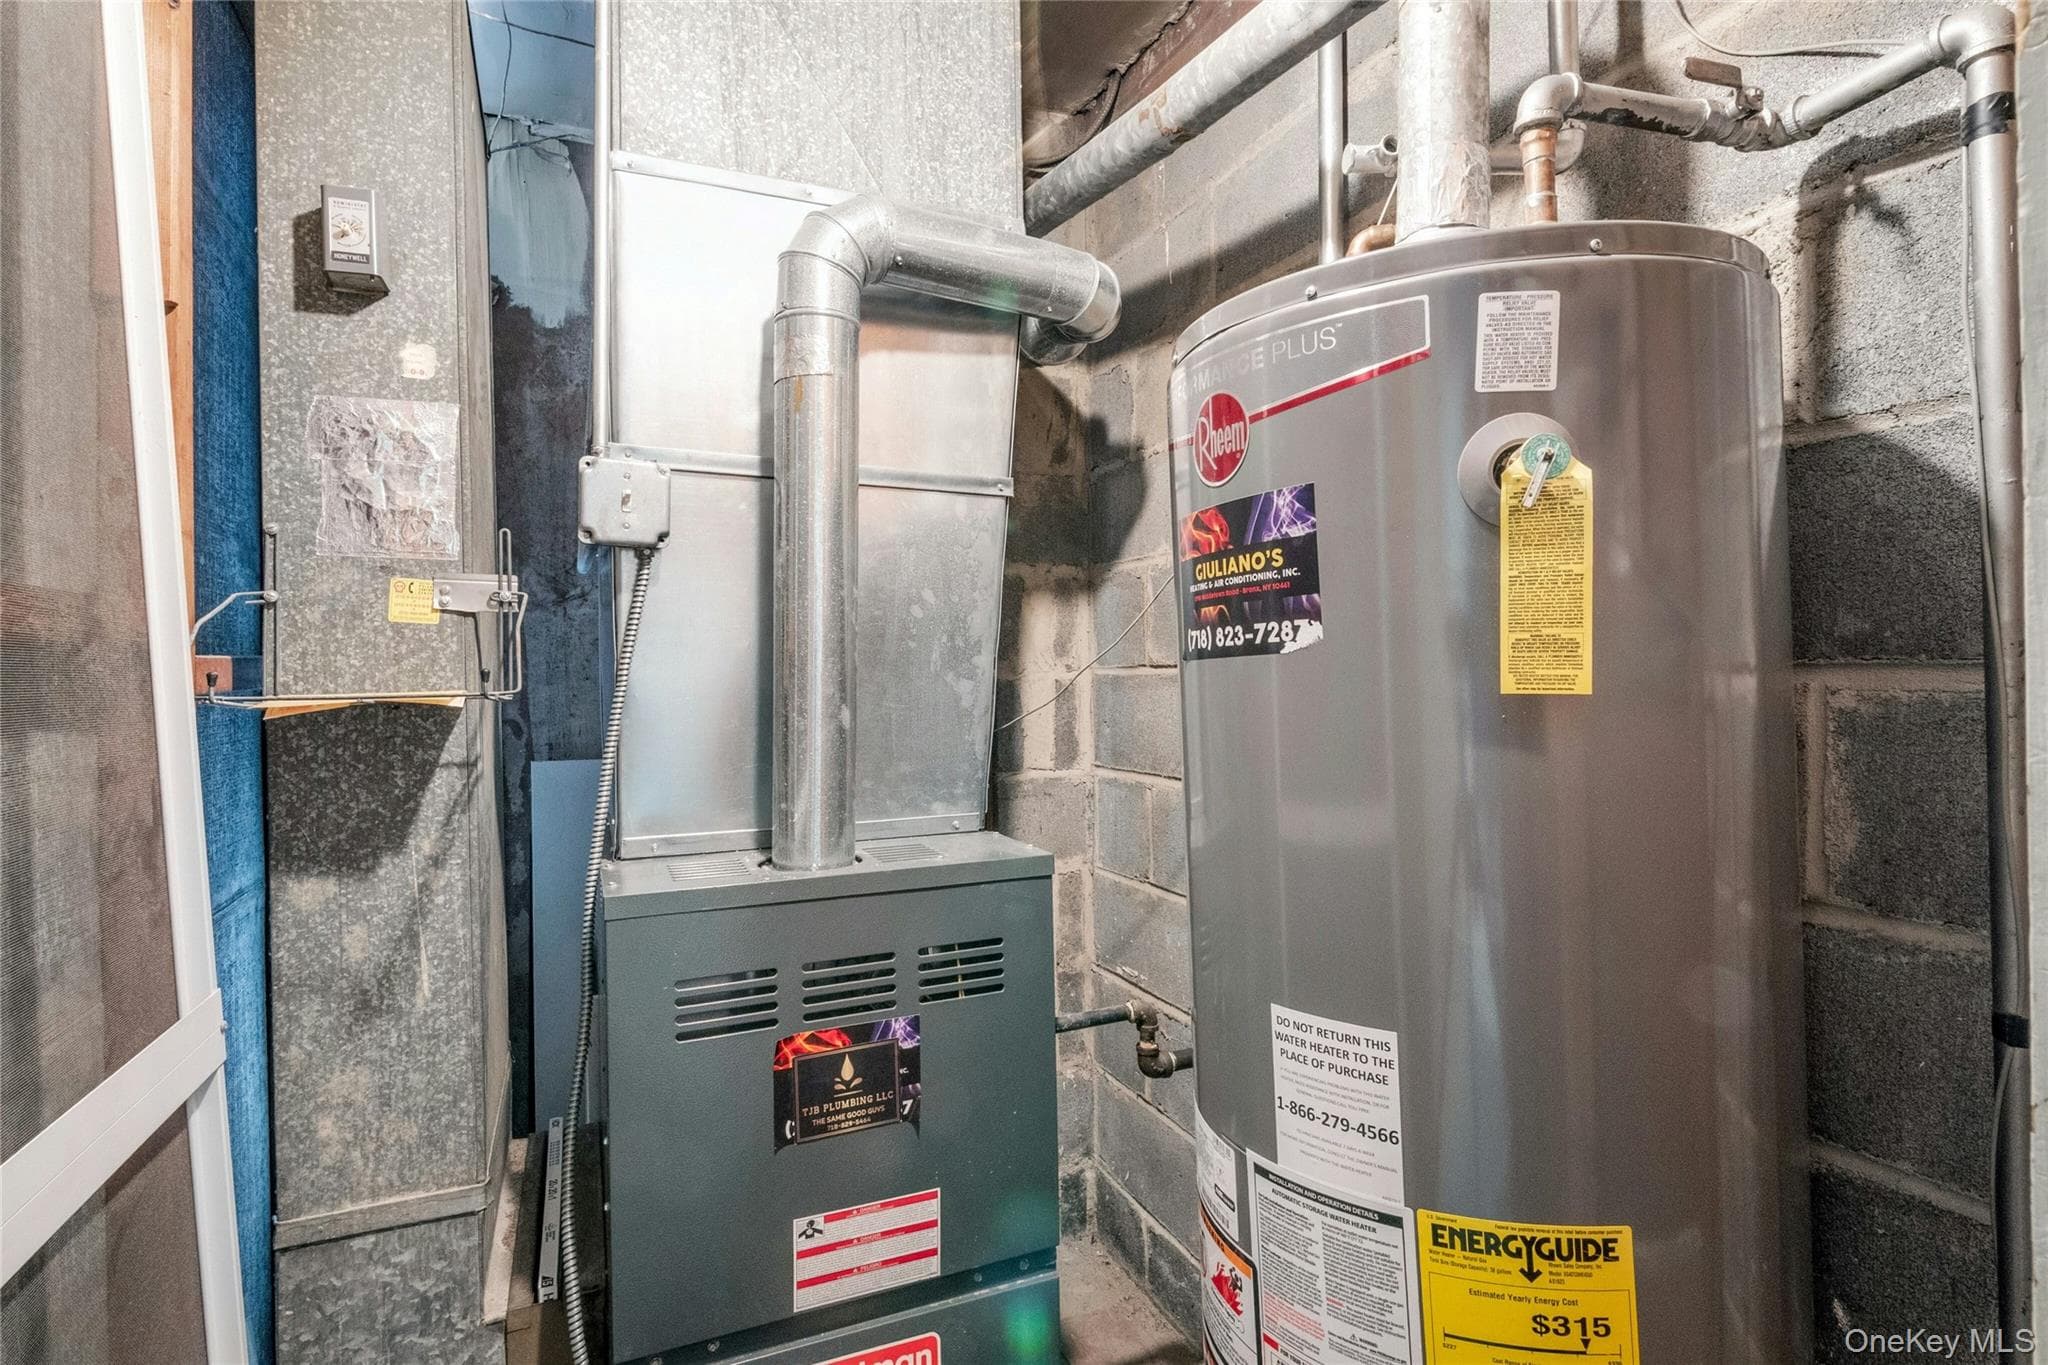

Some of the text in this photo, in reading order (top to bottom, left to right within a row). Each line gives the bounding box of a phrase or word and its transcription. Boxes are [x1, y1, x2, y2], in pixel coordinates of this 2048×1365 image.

[333, 253, 368, 262] HONEYWELL
[1198, 396, 1244, 472] Rheem
[1195, 548, 1284, 581] GIULIANO'S
[1214, 579, 1224, 588] AIR
[1224, 570, 1280, 586] CONDITIONING,
[1282, 567, 1301, 577] INC.
[1188, 626, 1212, 652] (718)
[1274, 1030, 1395, 1070] WATER HEATER TO THE
[1276, 1016, 1391, 1052] DO NOT RETURN THIS
[1280, 1048, 1389, 1085] PLACE OF PURCHASE
[802, 1091, 894, 1117] TJB PLUMBING LLC
[812, 1105, 886, 1126] THE SAME GOOD GUYS
[1277, 1096, 1399, 1145] 1-866-279-4566
[1269, 1173, 1379, 1220] INSTALLATION AND OPERATION DETAILS
[1272, 1188, 1377, 1233] AUTOMATIC STORAGE WATER HEATER
[1431, 1223, 1619, 1263] ENERGYGUIDE
[1469, 1288, 1578, 1306] Estimated Yearly Energy Cost
[1532, 1314, 1611, 1337] $315
